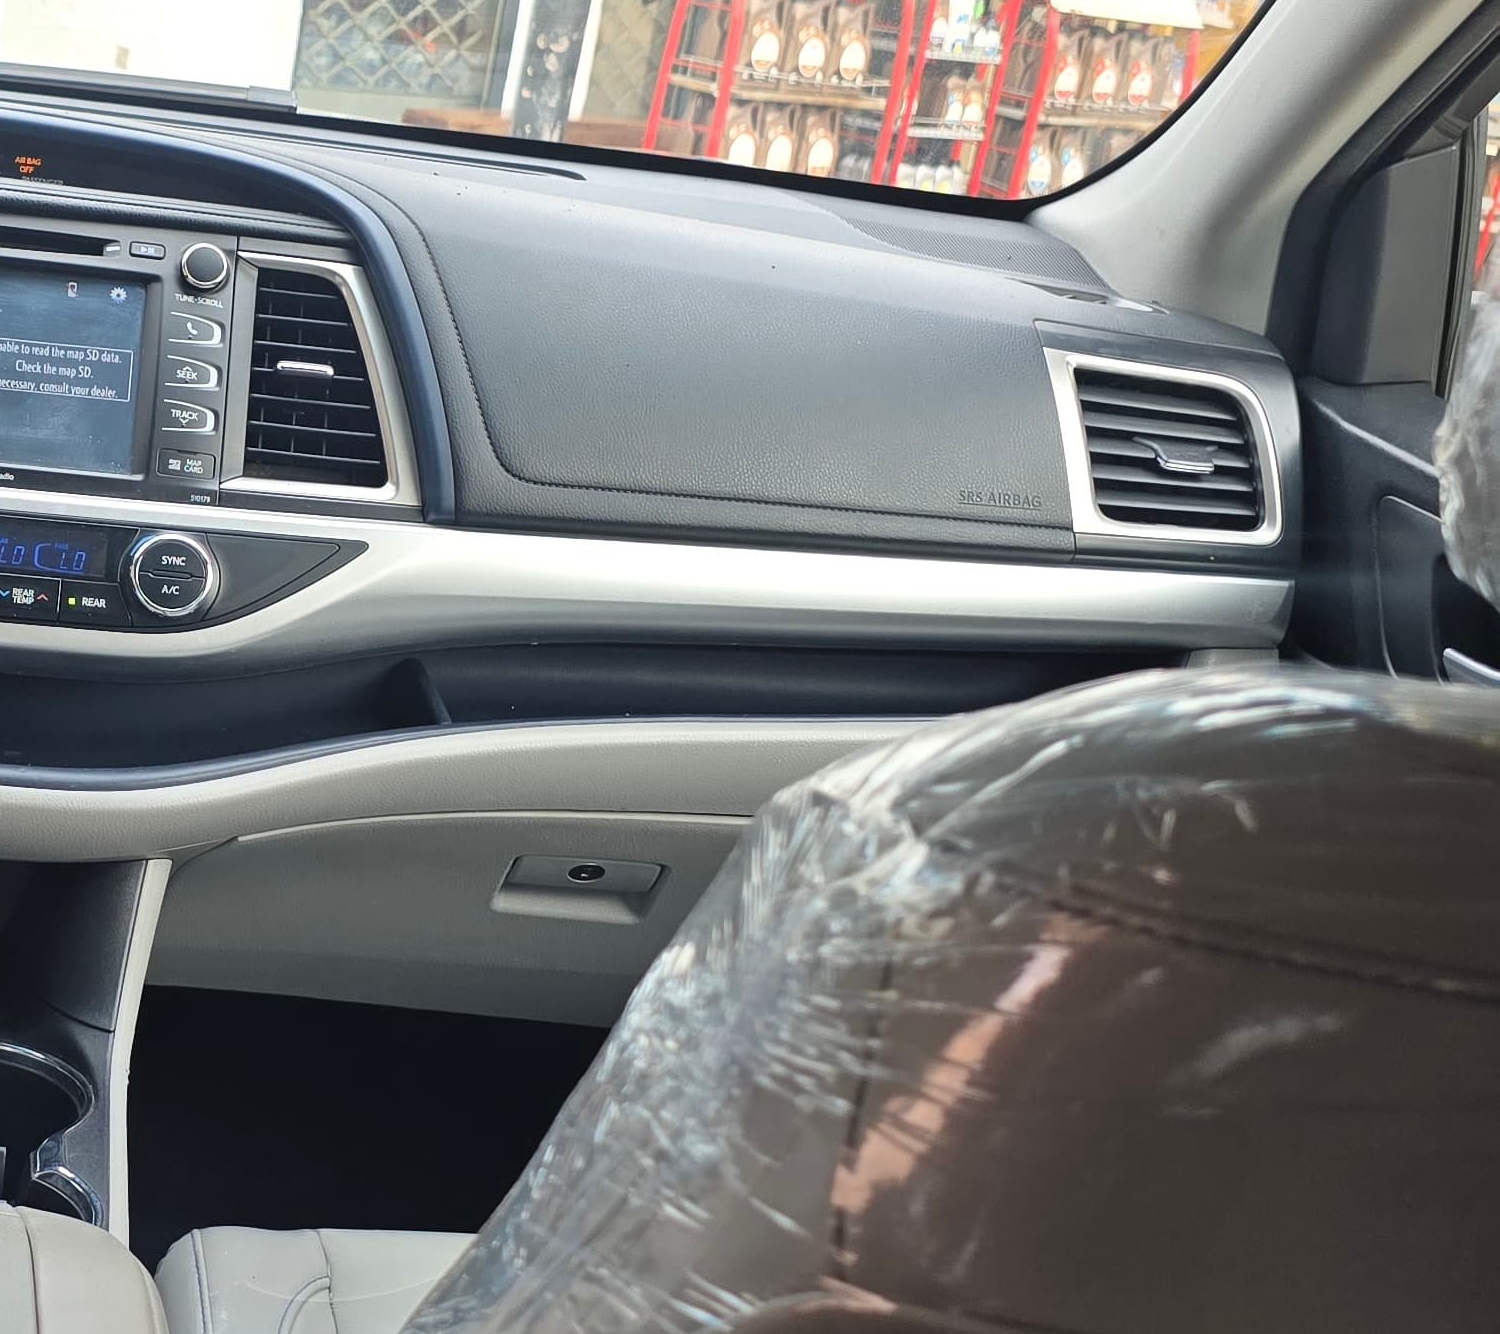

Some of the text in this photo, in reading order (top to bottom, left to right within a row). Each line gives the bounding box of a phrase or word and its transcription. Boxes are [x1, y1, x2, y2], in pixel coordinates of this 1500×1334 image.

[21, 344, 30, 354] to
[31, 345, 50, 356] read
[51, 346, 65, 358] the
[66, 350, 85, 362] map
[86, 349, 100, 361] SD
[101, 351, 122, 364] data.
[15, 359, 94, 379] Check the map SD.
[176, 369, 198, 381] SEEK
[39, 381, 69, 394] consult
[70, 384, 89, 396] your
[90, 385, 118, 398] dealer.
[171, 408, 199, 420] TRACK
[958, 490, 1042, 508] SRS AIRBAG
[161, 555, 187, 566] SYNC
[12, 587, 35, 598] REAR
[161, 584, 180, 595] A/C
[12, 595, 35, 605] TEMP
[81, 596, 107, 608] REAR
